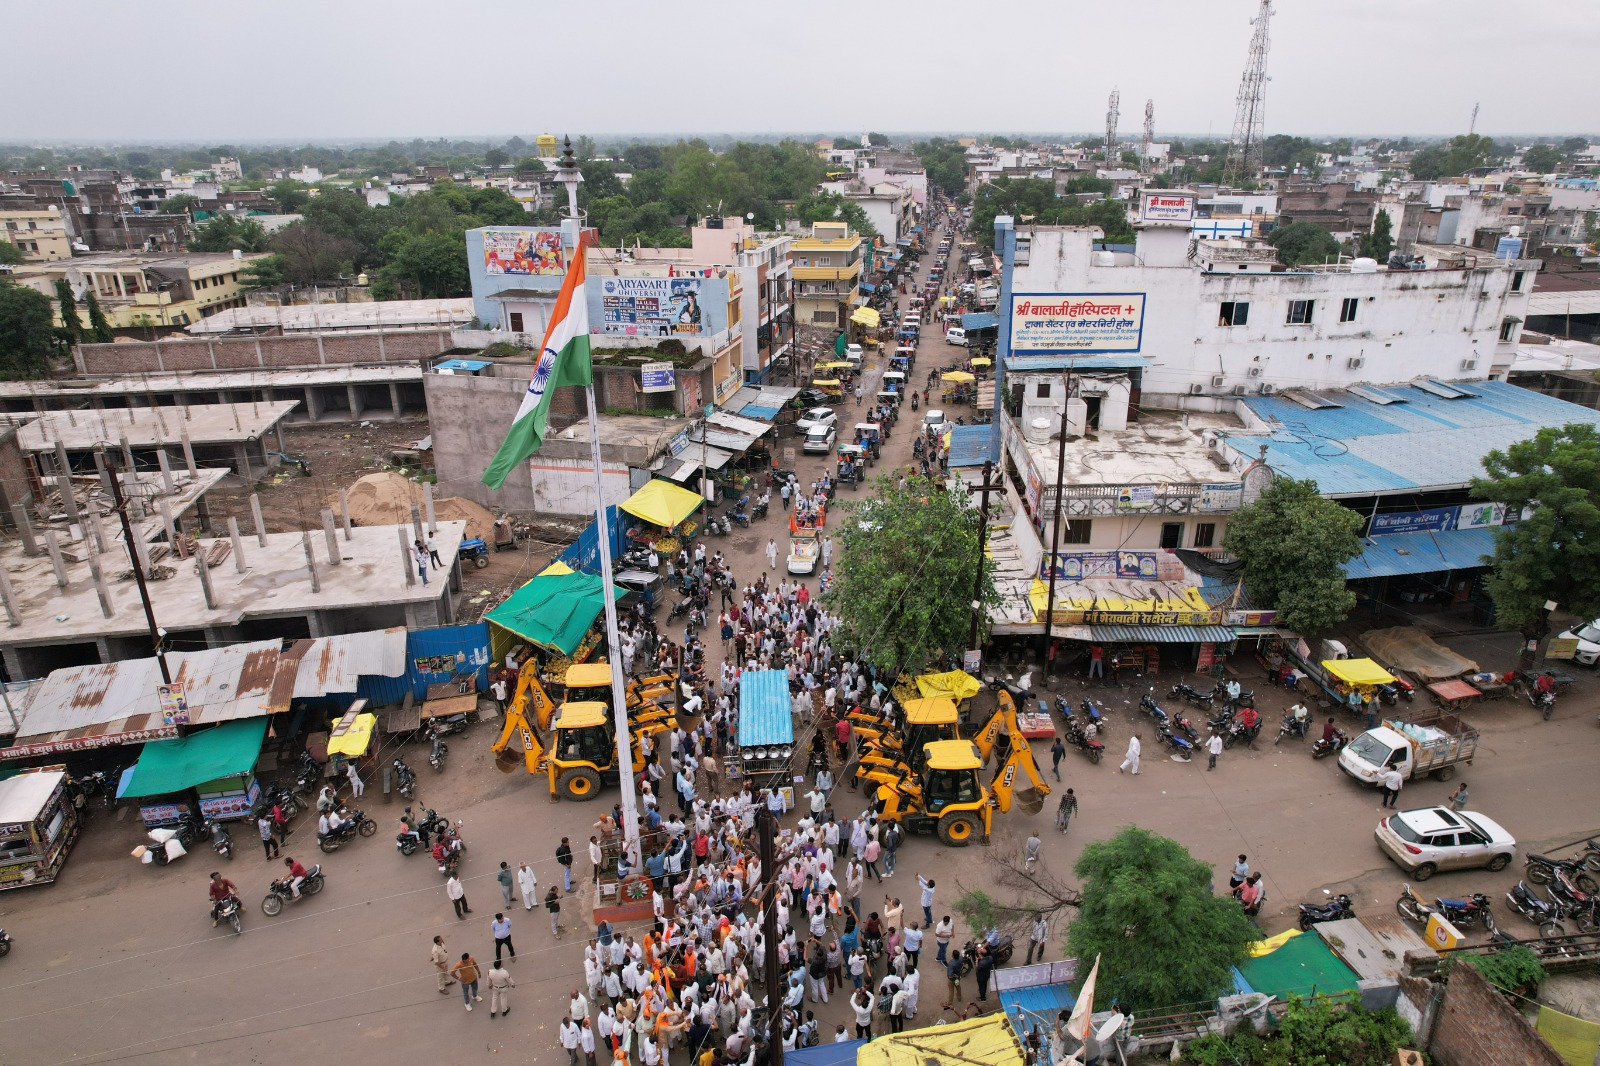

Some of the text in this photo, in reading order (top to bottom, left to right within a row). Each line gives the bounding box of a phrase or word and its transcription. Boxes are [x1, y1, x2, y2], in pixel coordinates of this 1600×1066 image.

[1161, 197, 1185, 206] बालाजी
[617, 279, 668, 290] ARYAVART
[1016, 301, 1122, 317] श्री बालाजी हॉस्पिटल
[1025, 320, 1044, 329] ट्रामा
[1045, 319, 1064, 328] सेंटर
[1078, 318, 1116, 328] मेटरनिटी
[1116, 318, 1134, 329] होम
[1086, 612, 1099, 622] माँ
[1100, 612, 1140, 623] शेरावाली
[533, 688, 544, 708] JCB
[523, 729, 532, 750] JCB
[985, 722, 999, 743] JCB
[2, 748, 30, 758] भवानी
[55, 742, 74, 751] सेंटर
[1003, 765, 1015, 787] JCB
